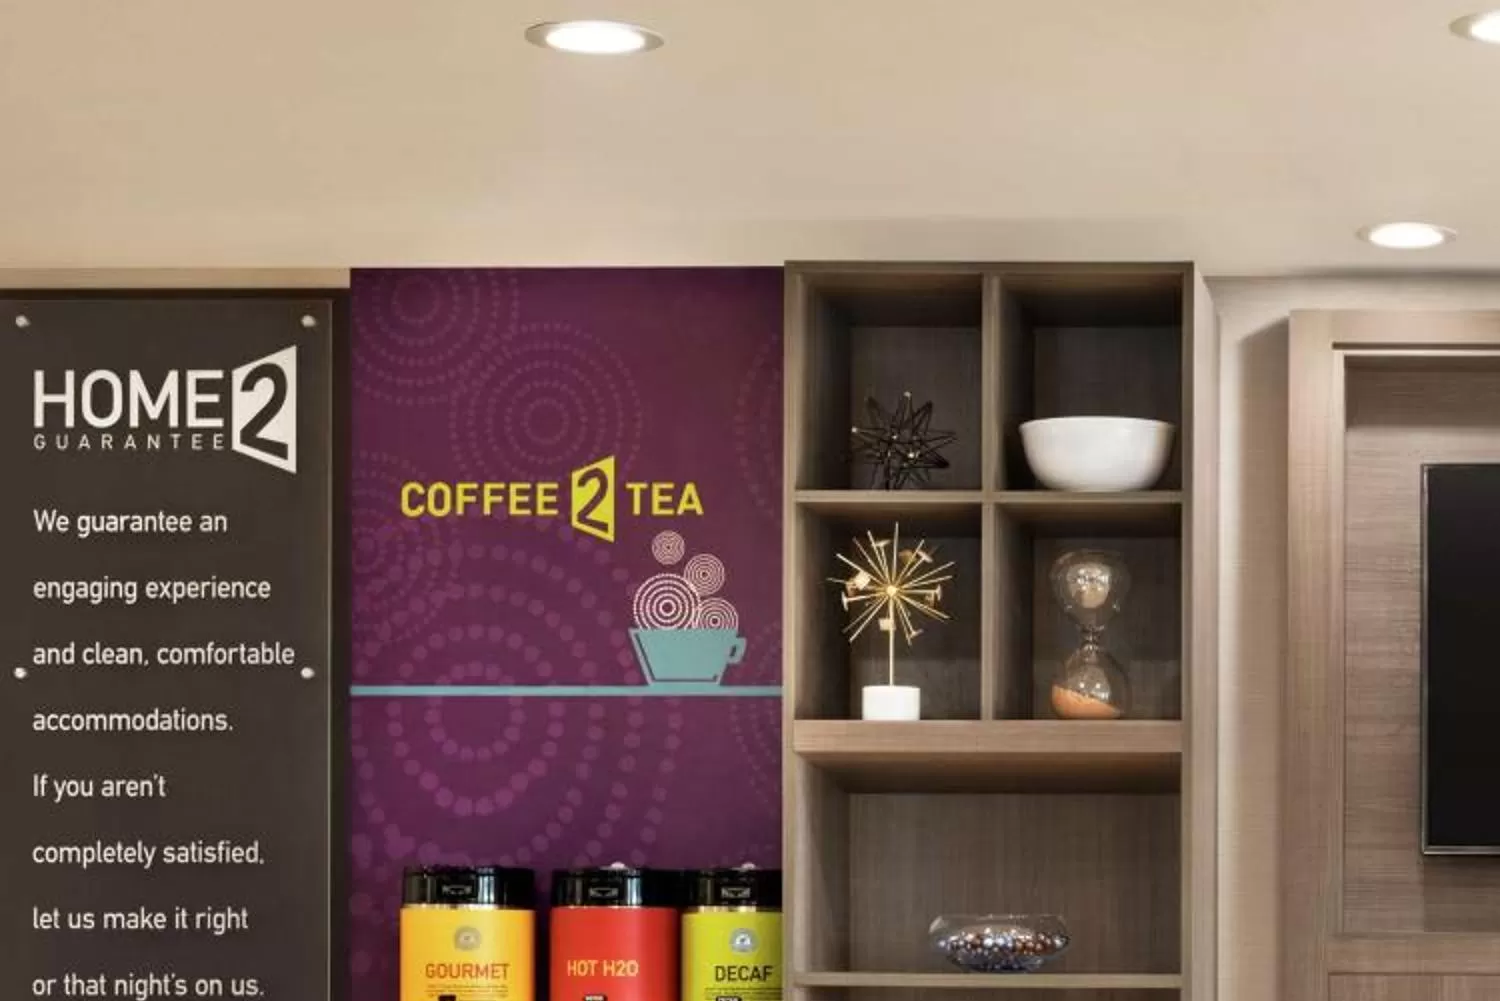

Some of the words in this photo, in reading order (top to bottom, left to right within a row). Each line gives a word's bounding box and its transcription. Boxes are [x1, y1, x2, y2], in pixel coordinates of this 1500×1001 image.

[33, 433, 225, 450] GUARANTEE
[400, 481, 559, 517] COFFEE
[625, 482, 704, 516] TEA
[33, 508, 70, 532] We
[77, 511, 193, 538] guarantee
[199, 514, 228, 532] an
[33, 576, 138, 604] engaging
[145, 576, 272, 604] experience
[32, 642, 75, 665] and
[82, 642, 149, 668] clean,
[156, 642, 295, 665] comfortable
[32, 708, 233, 731] accommodations.
[33, 774, 49, 797] If
[53, 779, 94, 803] you
[100, 774, 166, 797] aren't
[32, 840, 157, 869] completely
[32, 906, 61, 930] let
[68, 911, 95, 930] us
[103, 906, 167, 930] make
[174, 906, 188, 930] it
[195, 906, 249, 936] right
[424, 962, 511, 981] GOURMET
[567, 959, 599, 977] HOT
[714, 965, 774, 982] DECAF
[32, 978, 57, 996] or
[63, 973, 107, 996] that
[114, 973, 188, 1001] night's
[194, 978, 223, 996] on
[231, 978, 264, 996] us.
